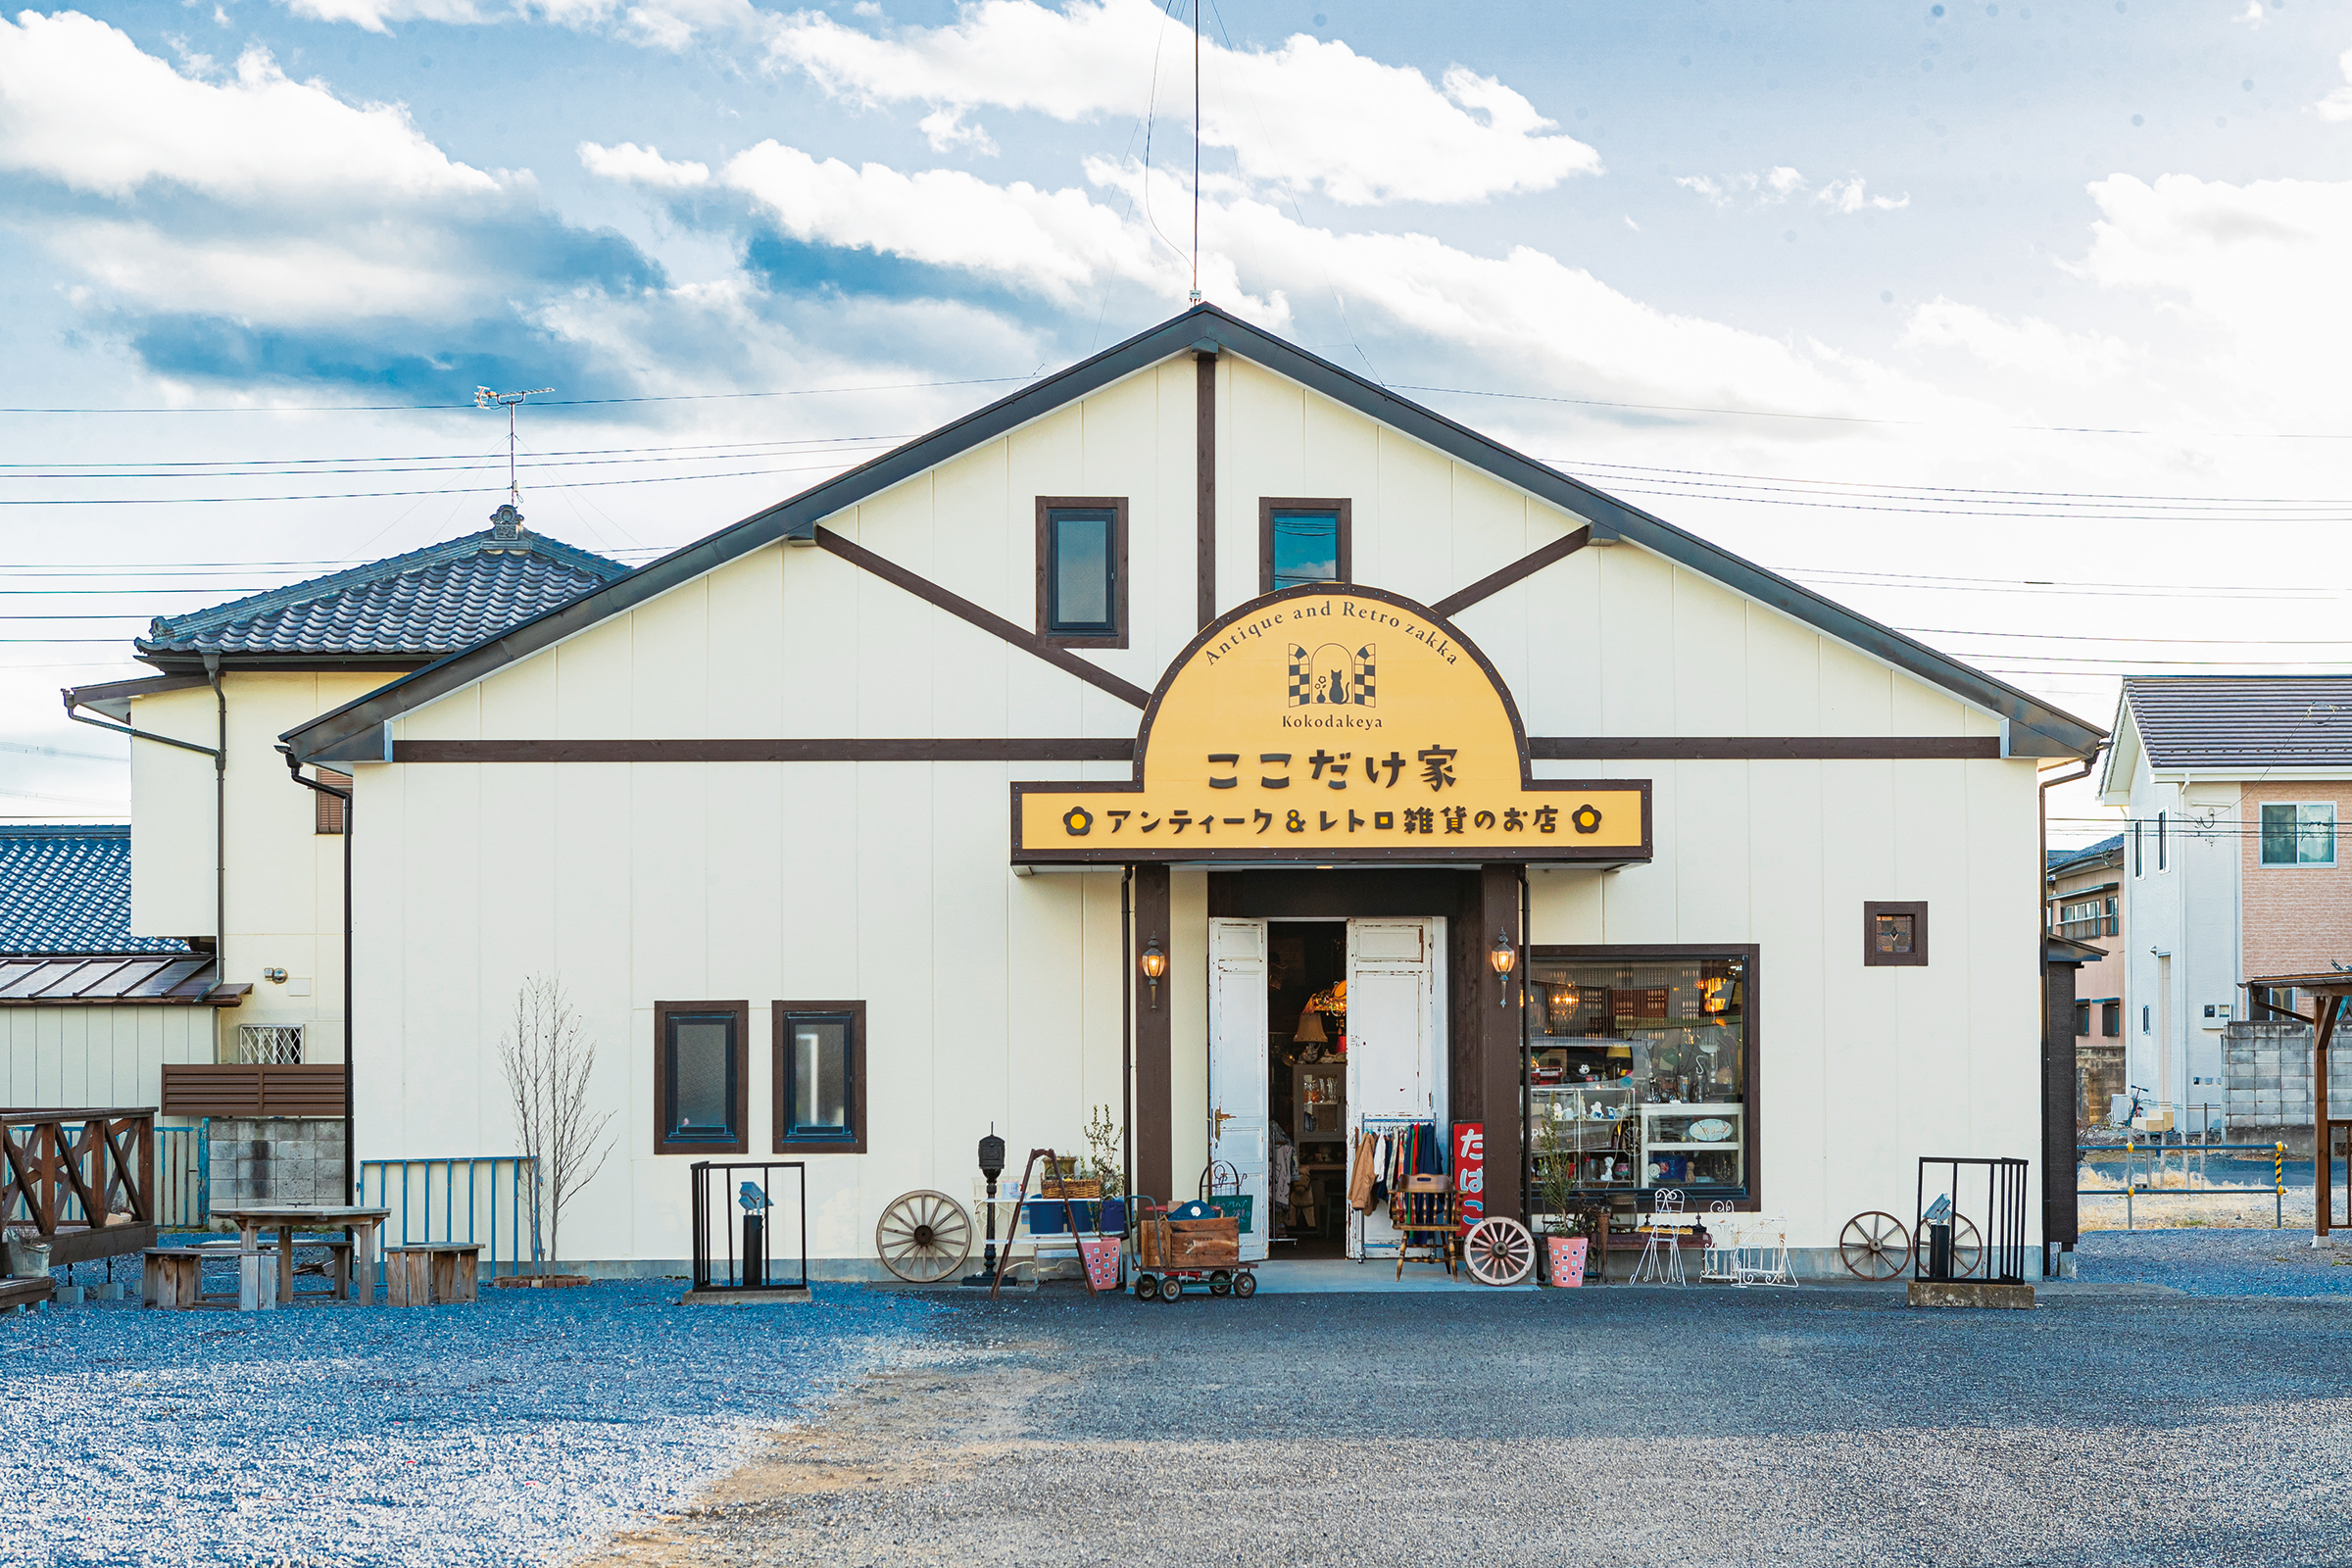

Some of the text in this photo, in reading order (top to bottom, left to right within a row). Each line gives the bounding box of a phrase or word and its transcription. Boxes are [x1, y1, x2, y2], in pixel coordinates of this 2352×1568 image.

[1204, 600, 1458, 666] Antique and Retro zakka
[1282, 714, 1383, 730] Kokodakeya
[1207, 744, 1458, 792] ここだけ家
[1106, 805, 1558, 834] アンティーク&レトロ雑貨のお店
